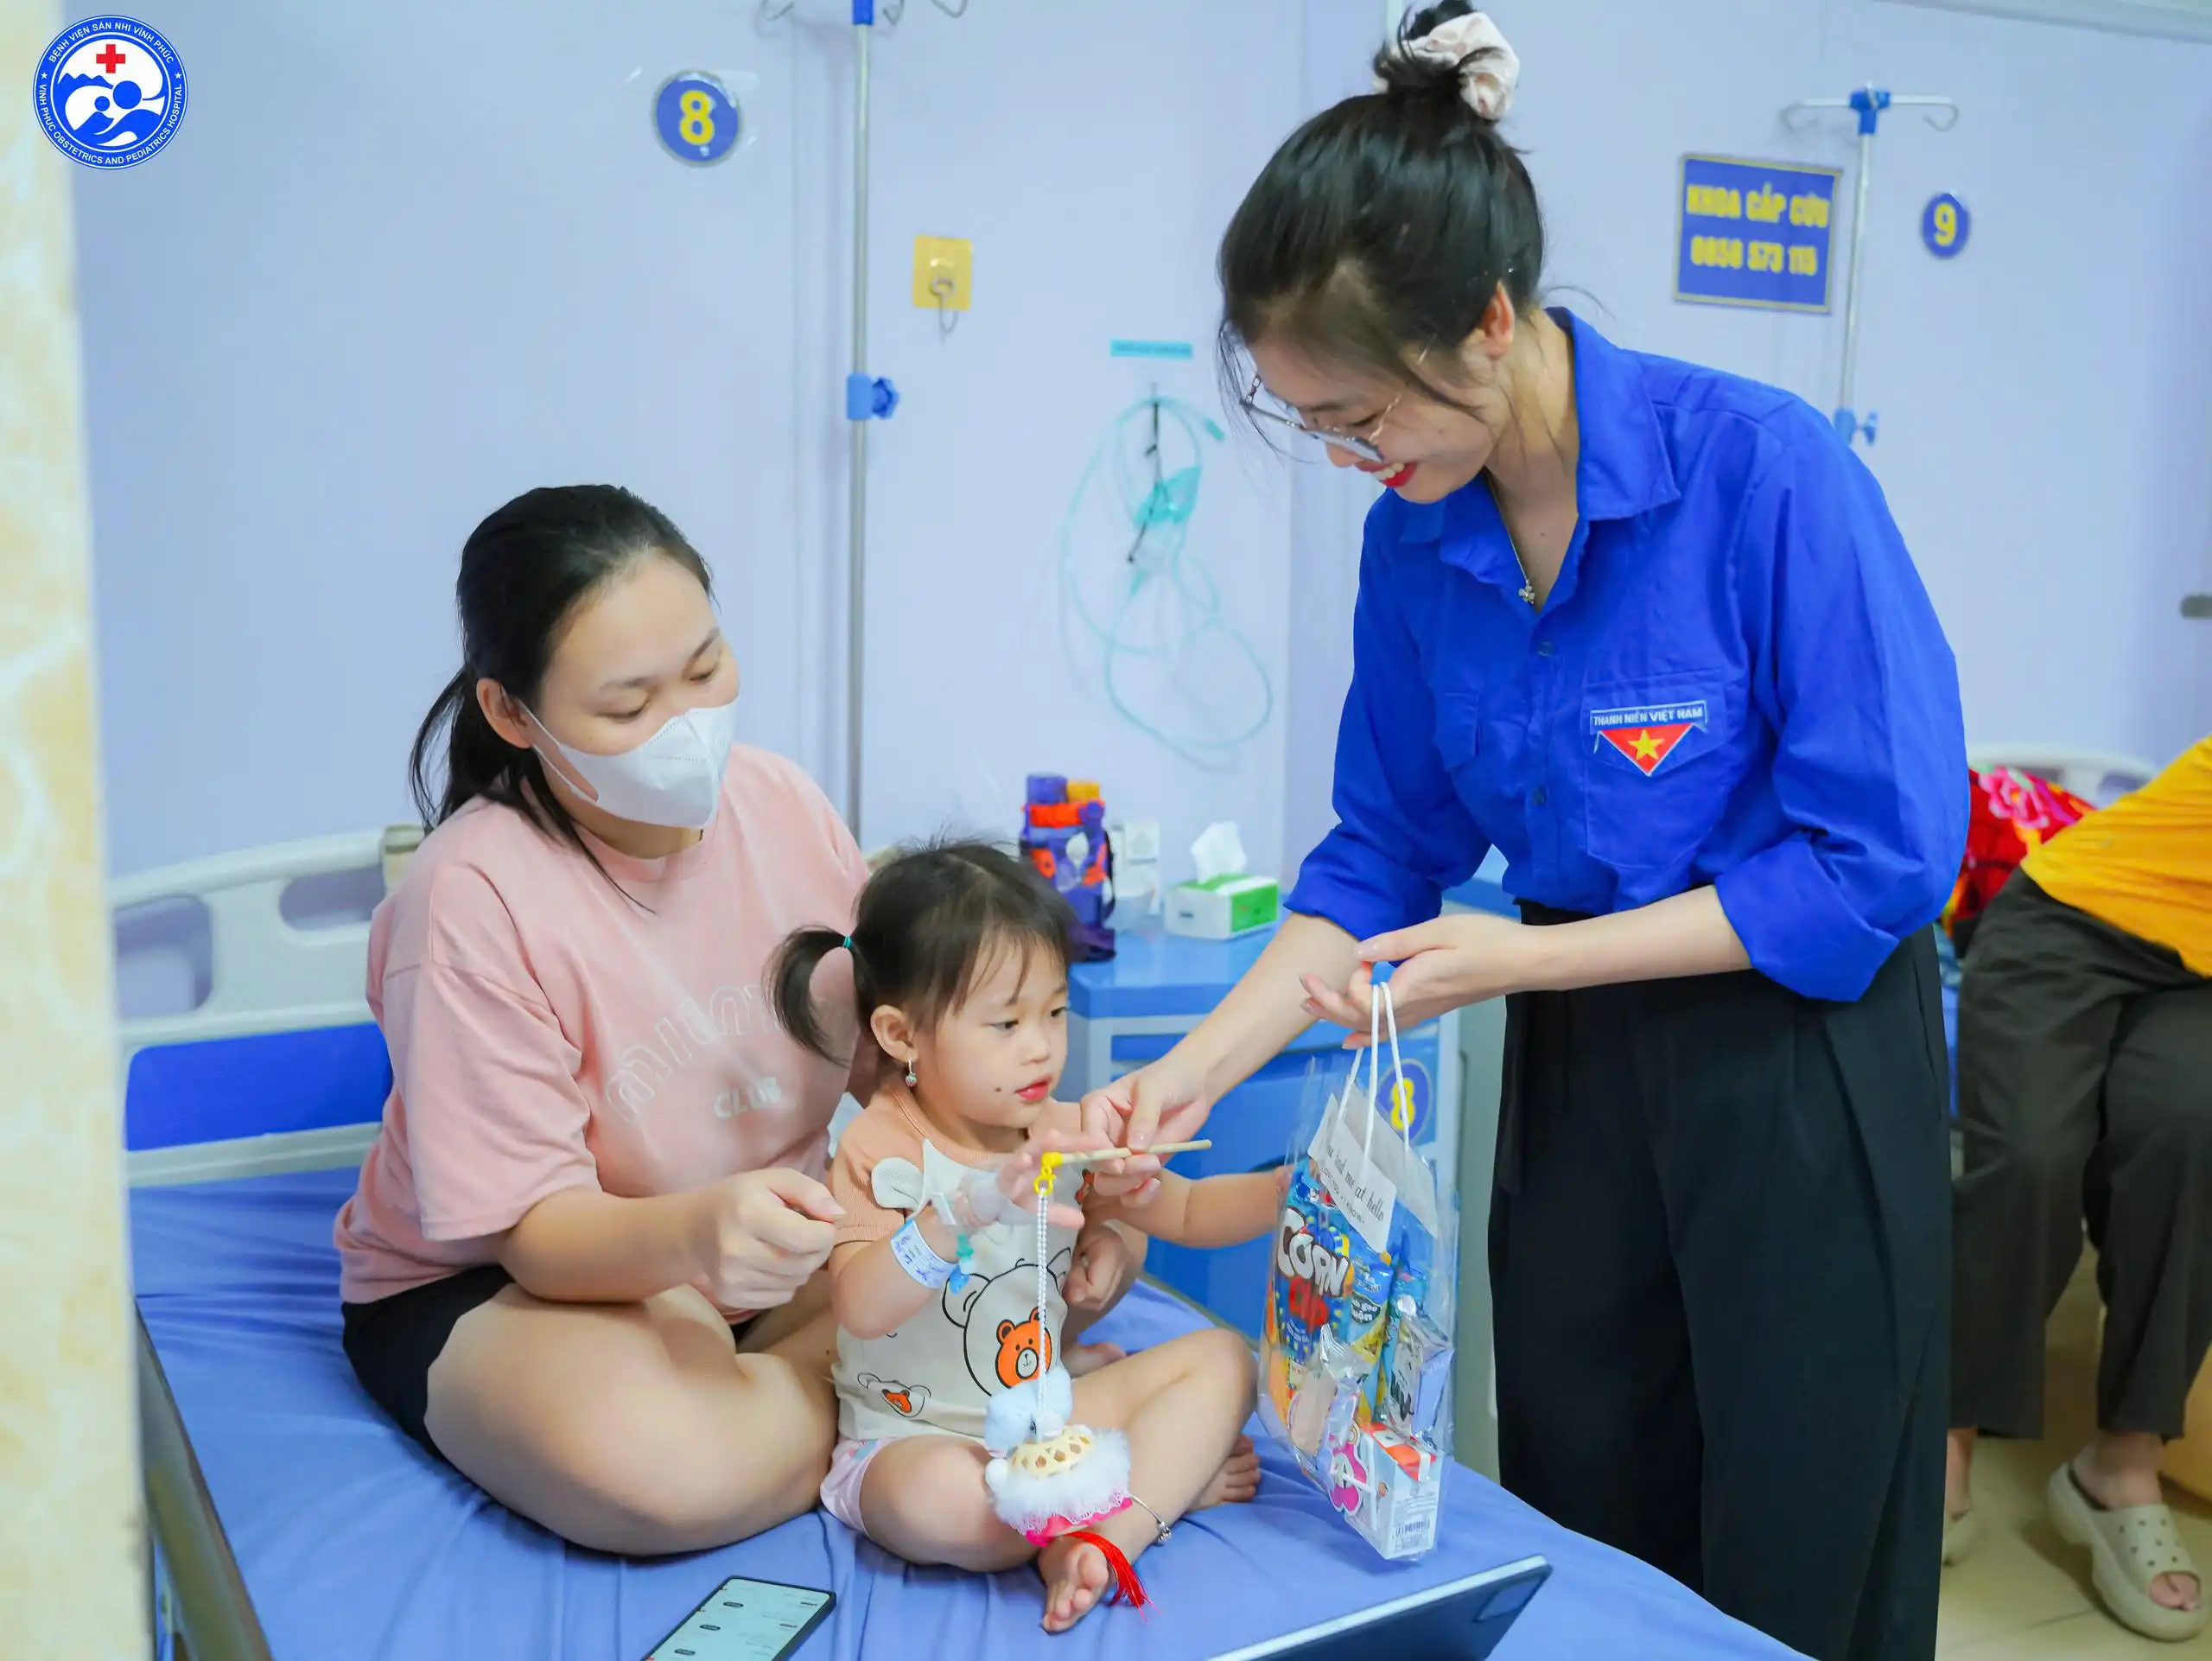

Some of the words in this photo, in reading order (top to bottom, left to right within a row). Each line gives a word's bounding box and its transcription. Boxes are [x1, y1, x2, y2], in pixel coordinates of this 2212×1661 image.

[679, 90, 715, 145] 8
[1933, 202, 1957, 247] 9
[1594, 715, 1623, 726] THANH
[1624, 712, 1648, 723] NIÊN
[1649, 710, 1675, 722] VIỆT
[1677, 707, 1703, 719] NAM
[1389, 1078, 1416, 1130] 8
[1367, 1192, 1385, 1223] hello
[1277, 1206, 1351, 1297] CORN
